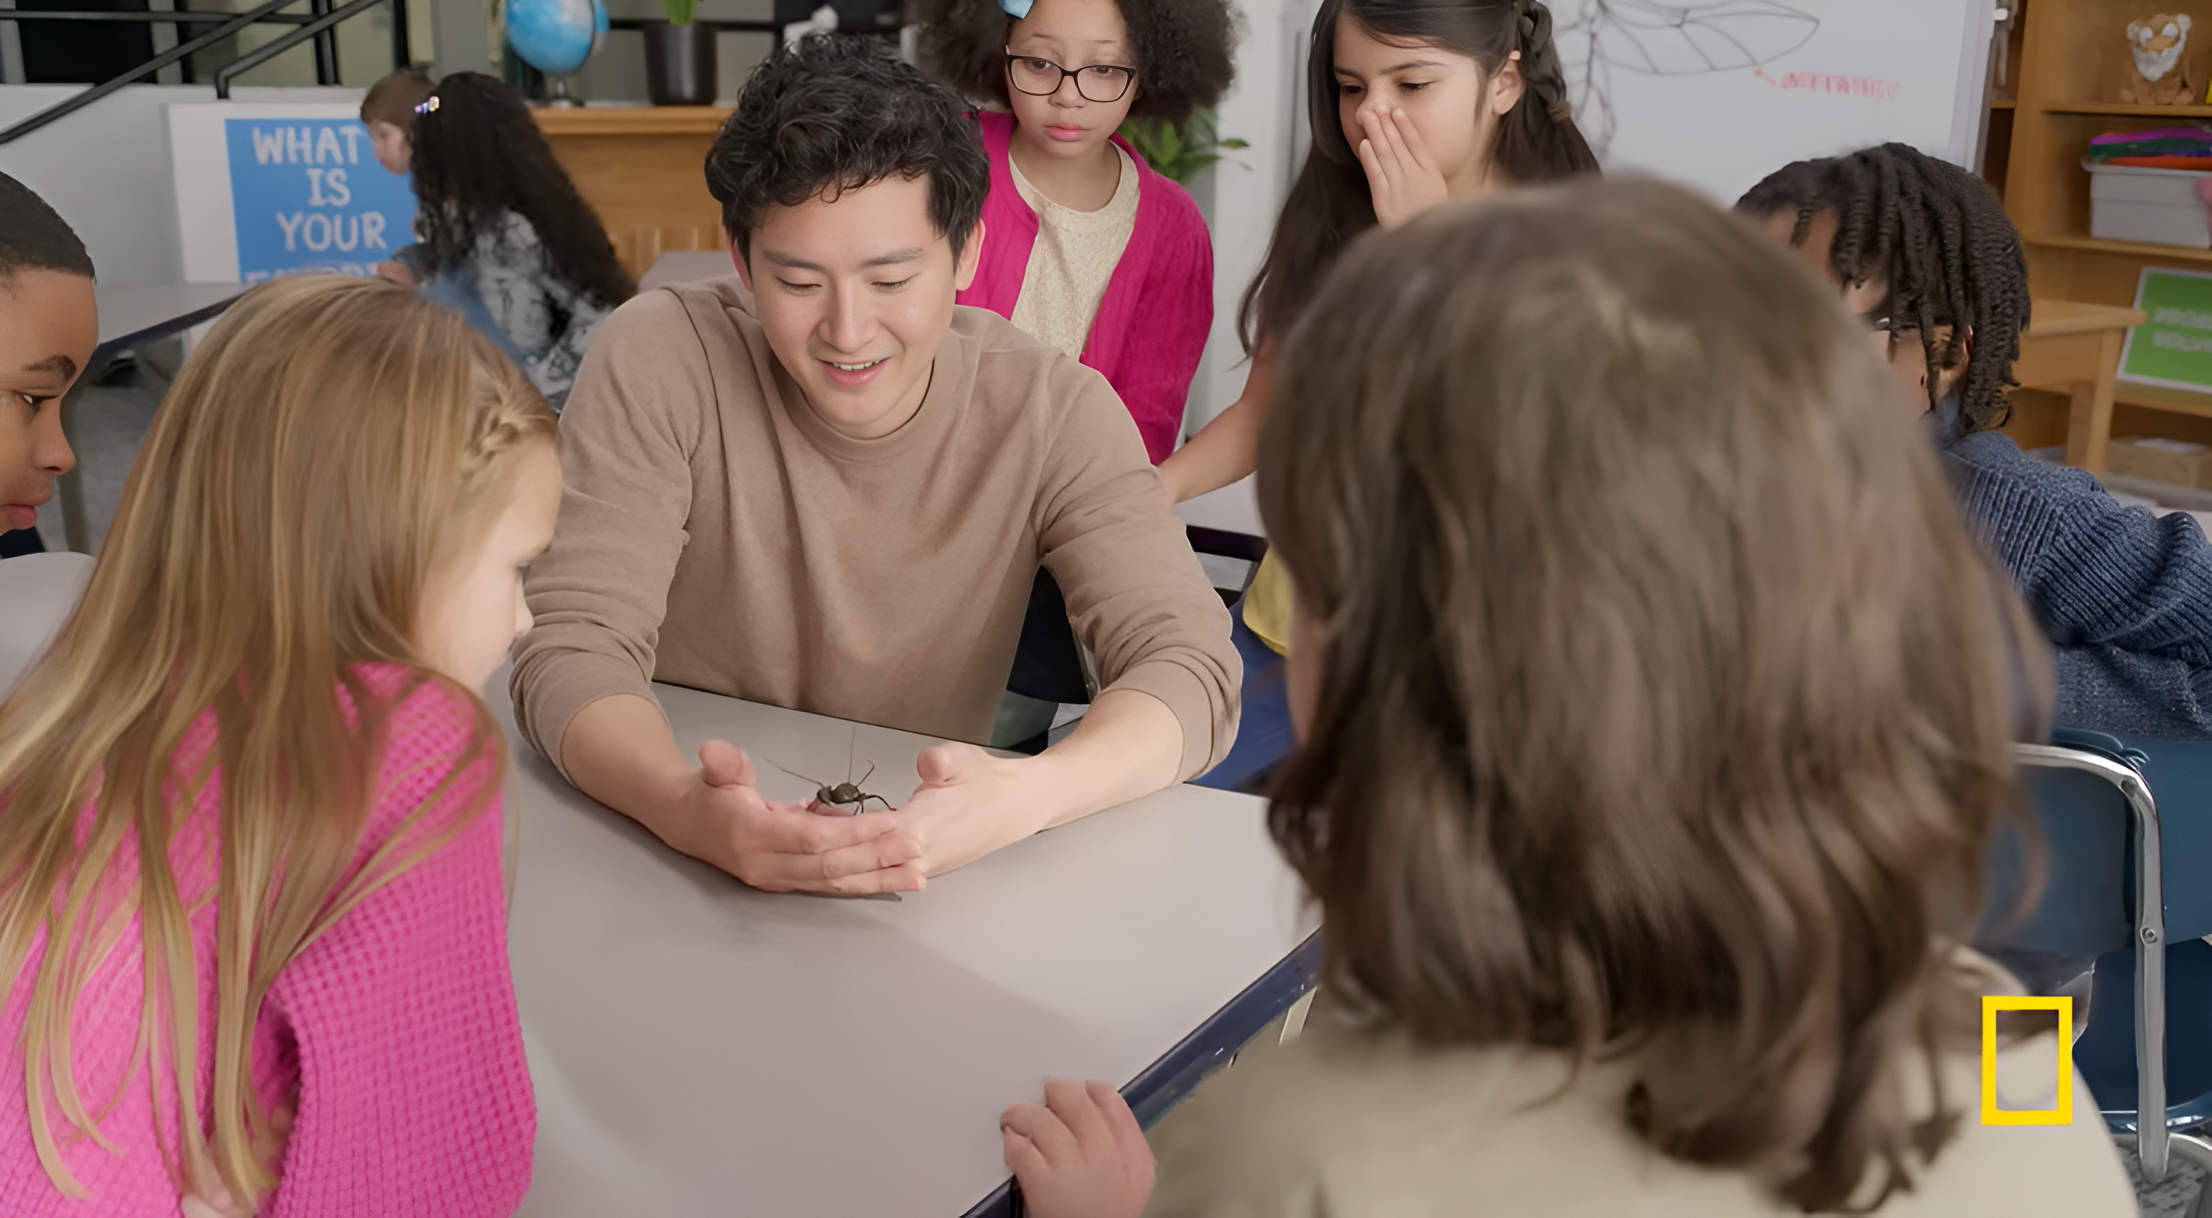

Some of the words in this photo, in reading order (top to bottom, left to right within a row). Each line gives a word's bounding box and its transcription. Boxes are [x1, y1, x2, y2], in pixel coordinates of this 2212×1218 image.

[252, 125, 366, 165] WHAT
[306, 168, 350, 207] IS
[275, 211, 388, 251] YOUR
